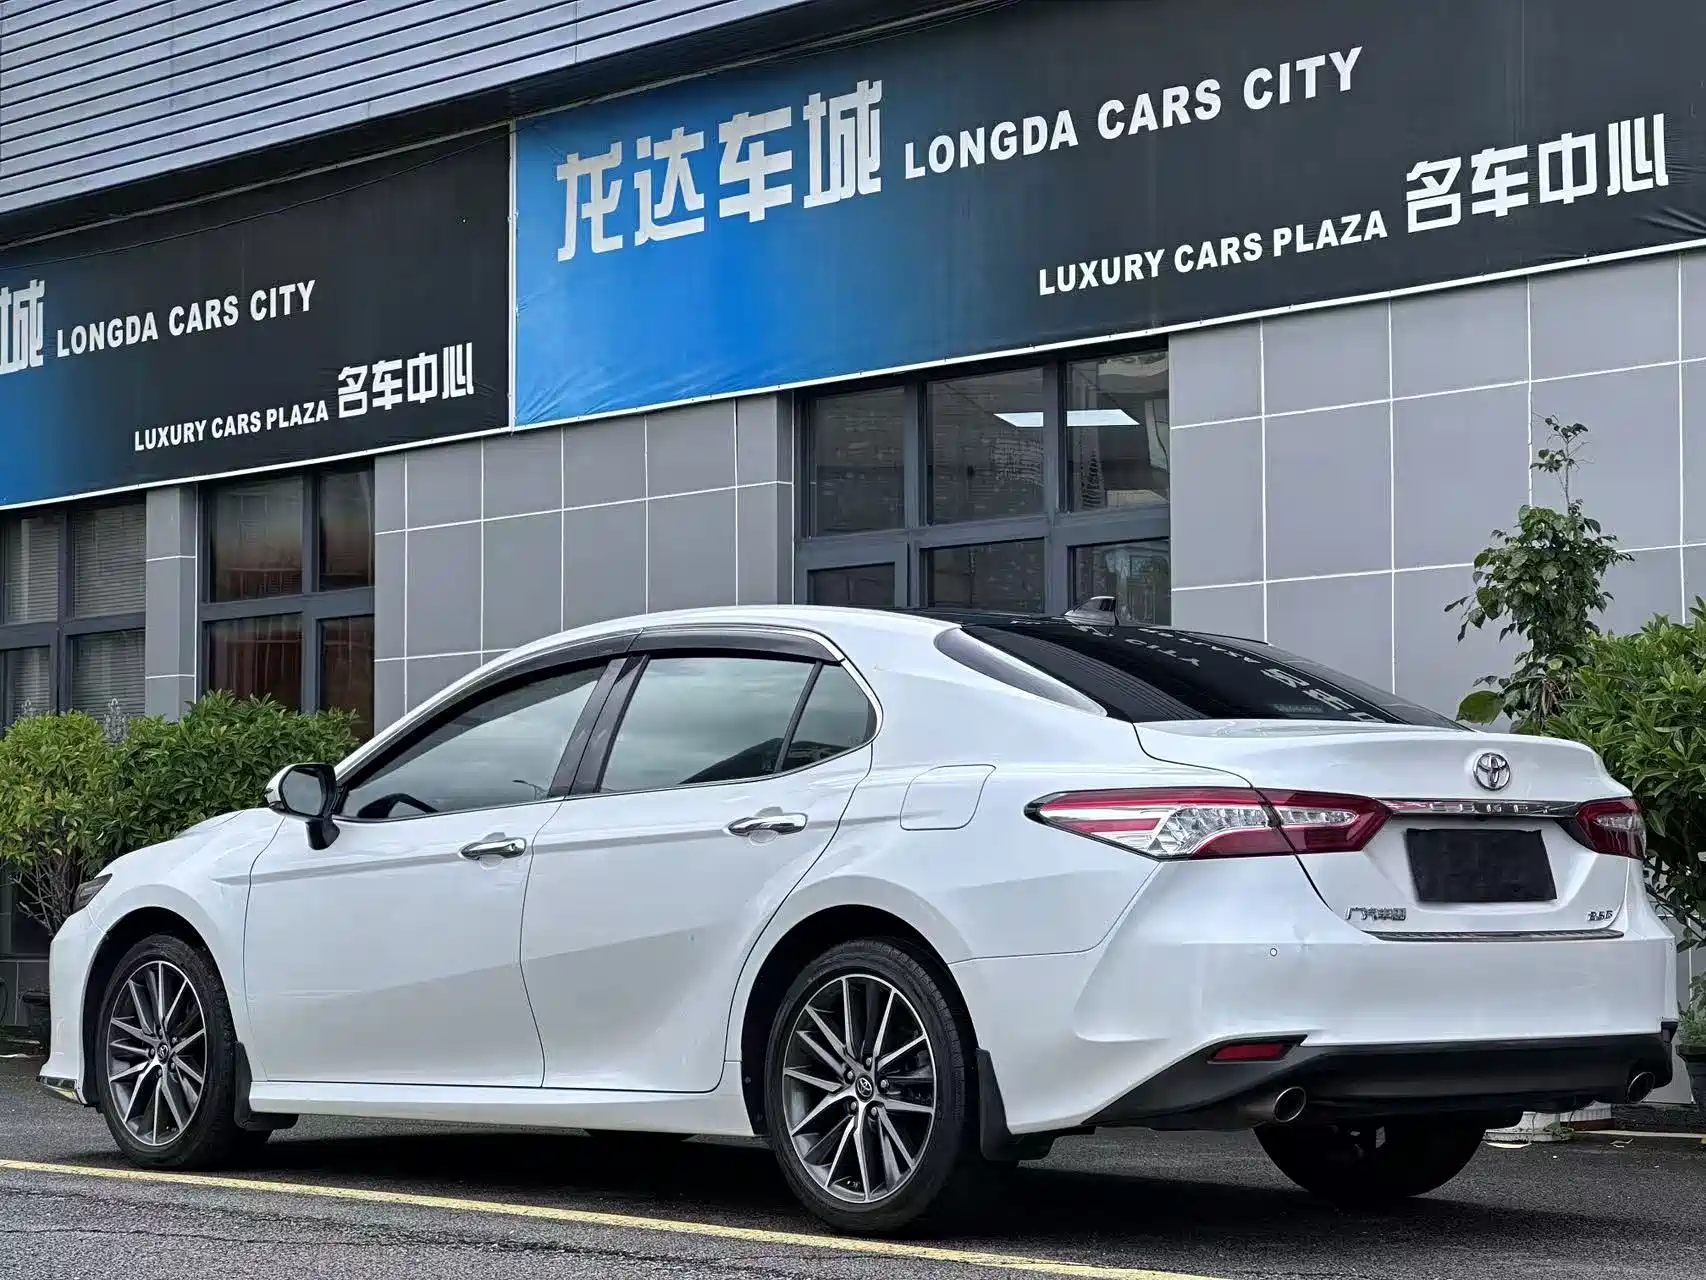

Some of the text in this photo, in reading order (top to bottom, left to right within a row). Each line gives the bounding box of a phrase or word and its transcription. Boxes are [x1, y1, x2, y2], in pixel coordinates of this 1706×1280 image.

[905, 46, 1363, 180] LONGDA CARS CITY
[557, 80, 882, 262] 龙达车城
[1406, 113, 1670, 233] 名车中心
[1039, 210, 1388, 296] LUXURY CARS PLAZA
[57, 279, 316, 358] LONGDA CARS CITY
[337, 342, 475, 419] 名车中心
[134, 400, 329, 451] LUXURY CARS PLAZA
